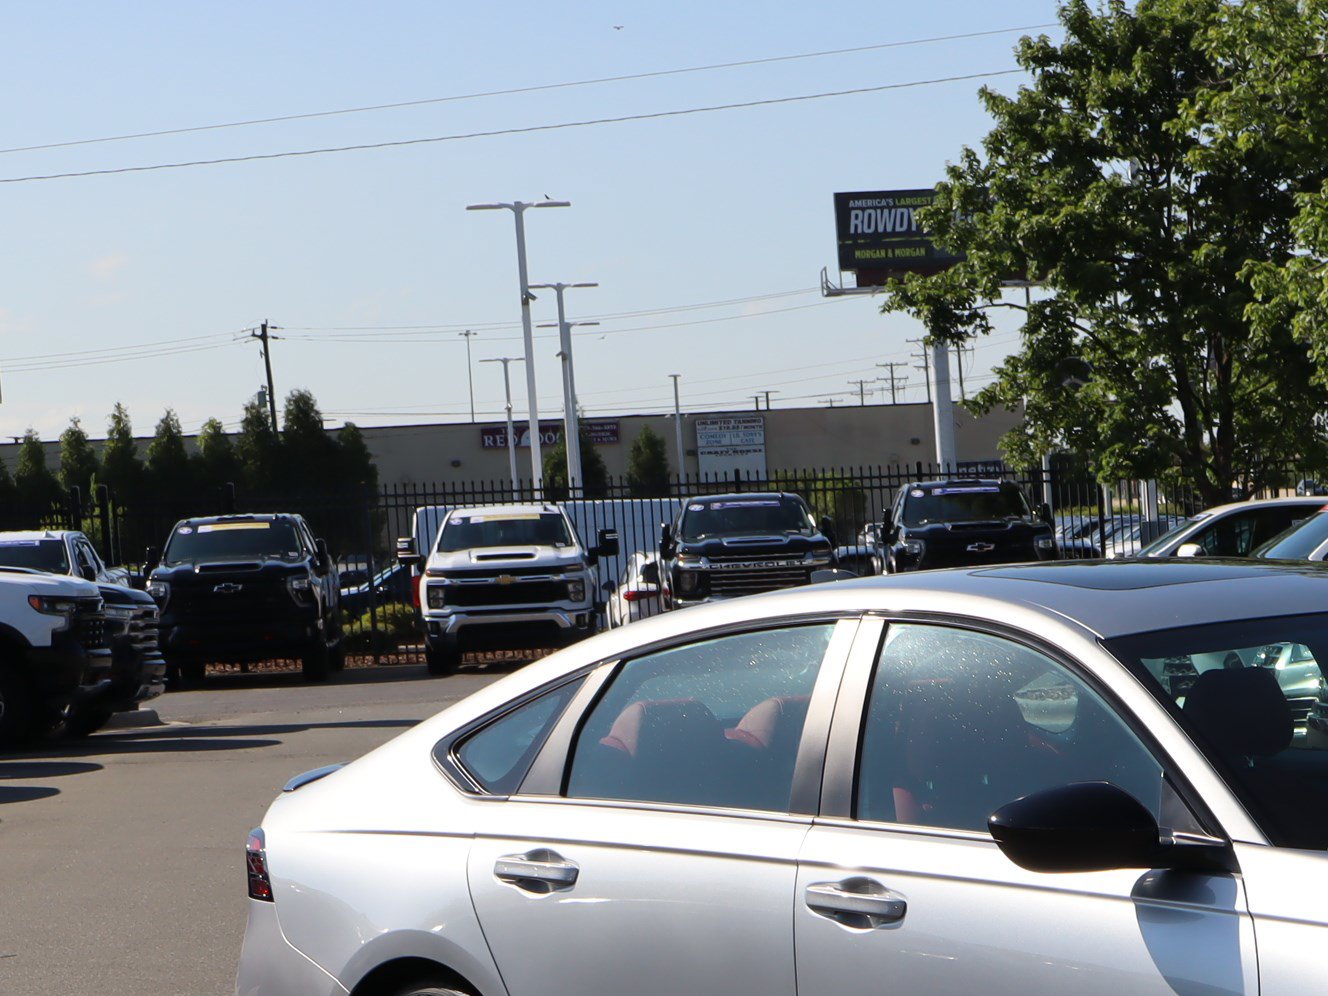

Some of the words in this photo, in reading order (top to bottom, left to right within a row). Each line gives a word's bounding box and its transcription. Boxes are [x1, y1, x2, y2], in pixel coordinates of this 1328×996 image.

[849, 199, 894, 208] AMERICA'S
[895, 197, 931, 206] LARGEST
[855, 249, 886, 259] MORGAN
[887, 249, 893, 258] &
[895, 247, 926, 257] MORGAN
[709, 559, 807, 570] CHEVROLET
